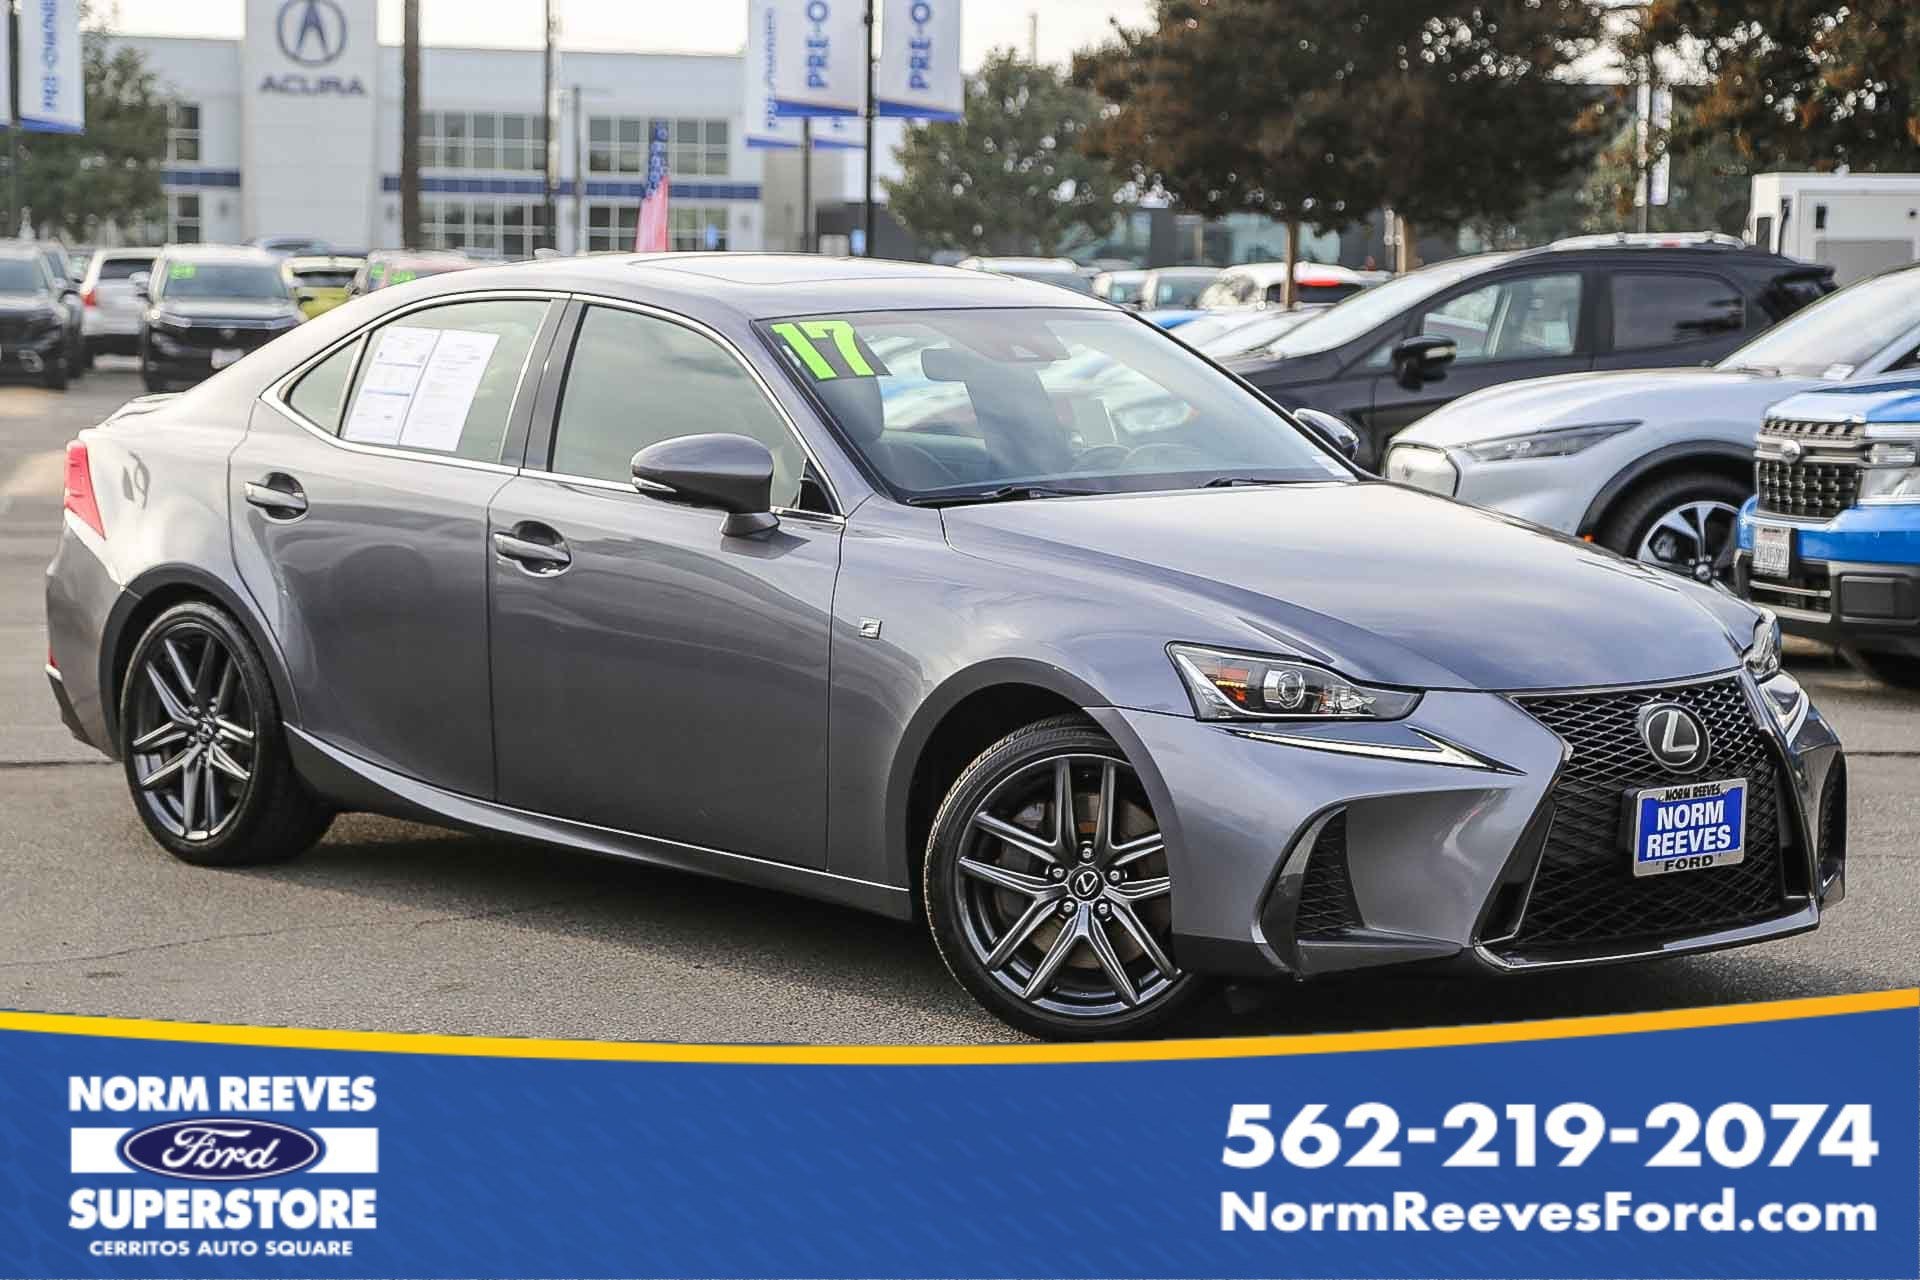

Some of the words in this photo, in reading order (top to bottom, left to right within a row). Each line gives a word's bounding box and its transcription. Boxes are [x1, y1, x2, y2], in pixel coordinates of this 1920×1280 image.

[259, 75, 366, 96] ACURA
[771, 320, 874, 379] 17
[1665, 787, 1691, 801] NORM
[1692, 783, 1721, 797] REEVES
[1657, 800, 1724, 831] NORM
[1646, 825, 1730, 857] REEVES
[1664, 855, 1713, 872] FORD
